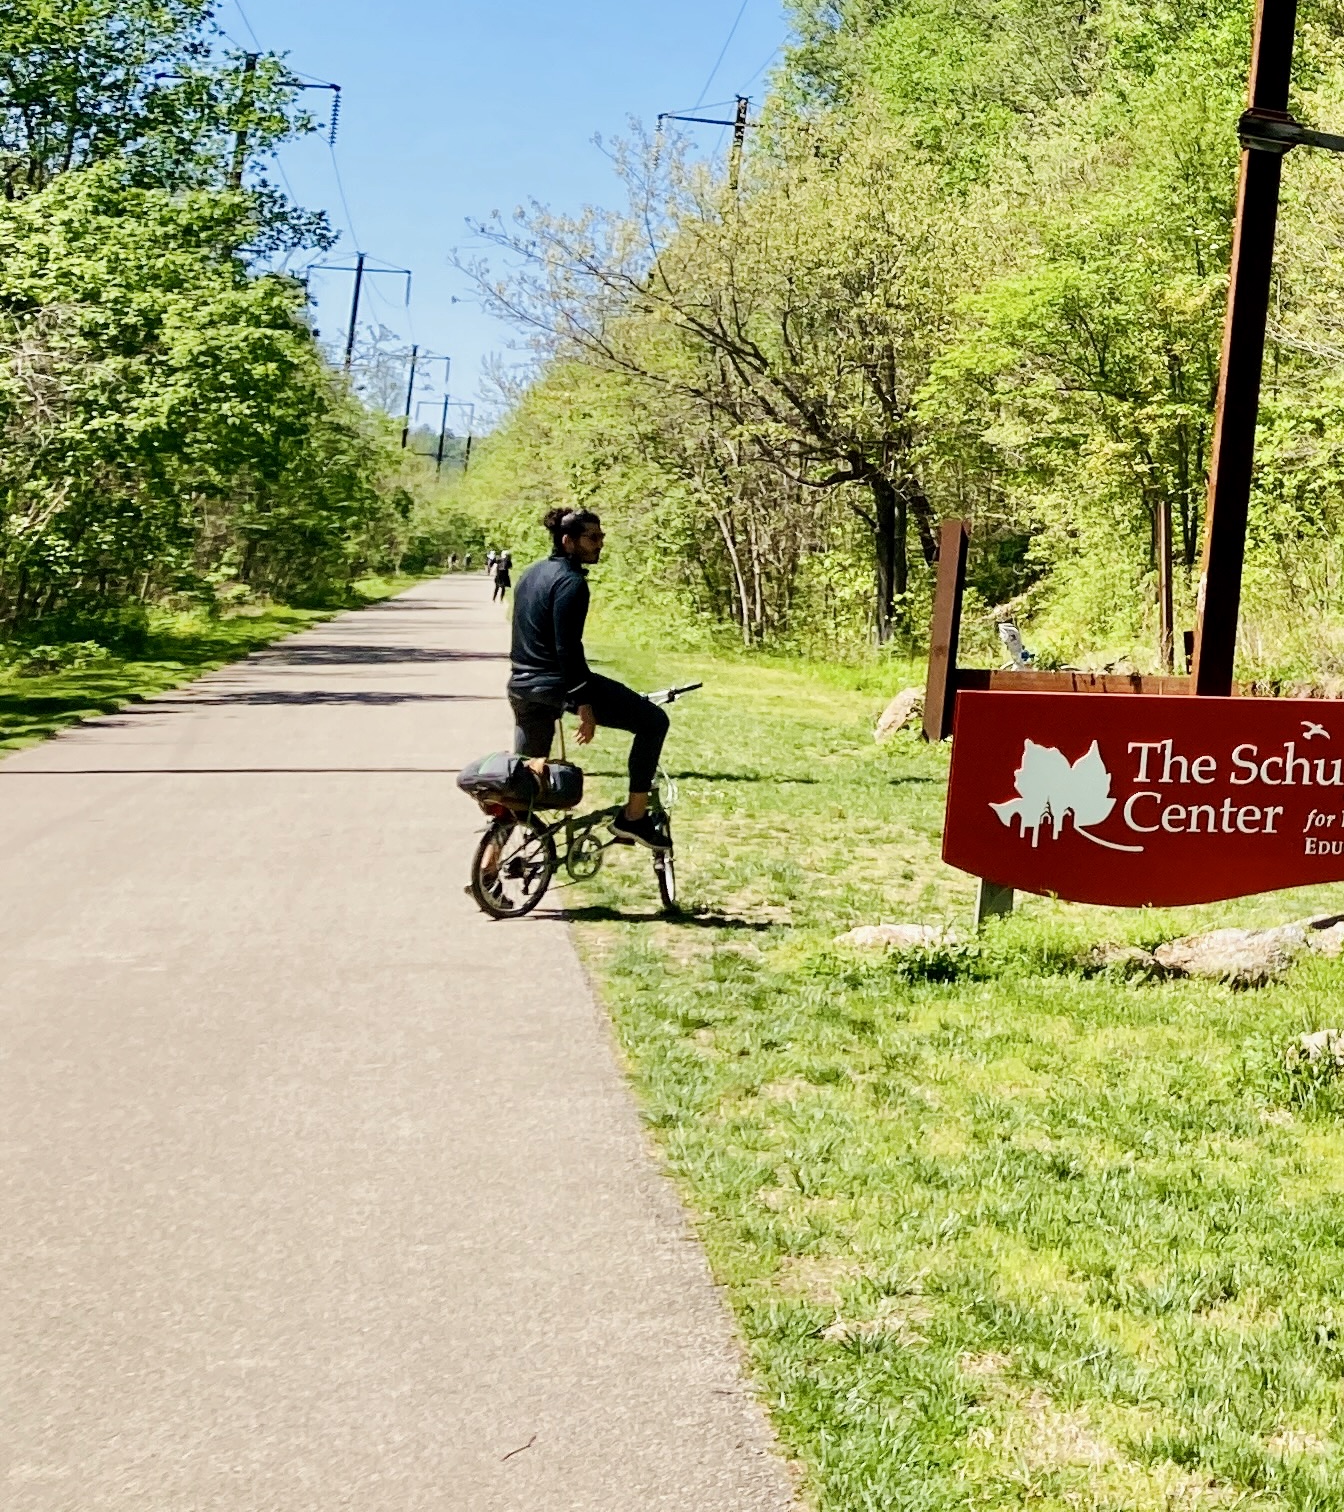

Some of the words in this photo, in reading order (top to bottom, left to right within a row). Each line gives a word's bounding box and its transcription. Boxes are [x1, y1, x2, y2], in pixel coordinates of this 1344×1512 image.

[1127, 738, 1217, 785] The
[1123, 791, 1284, 834] Center
[1302, 808, 1336, 834] for
